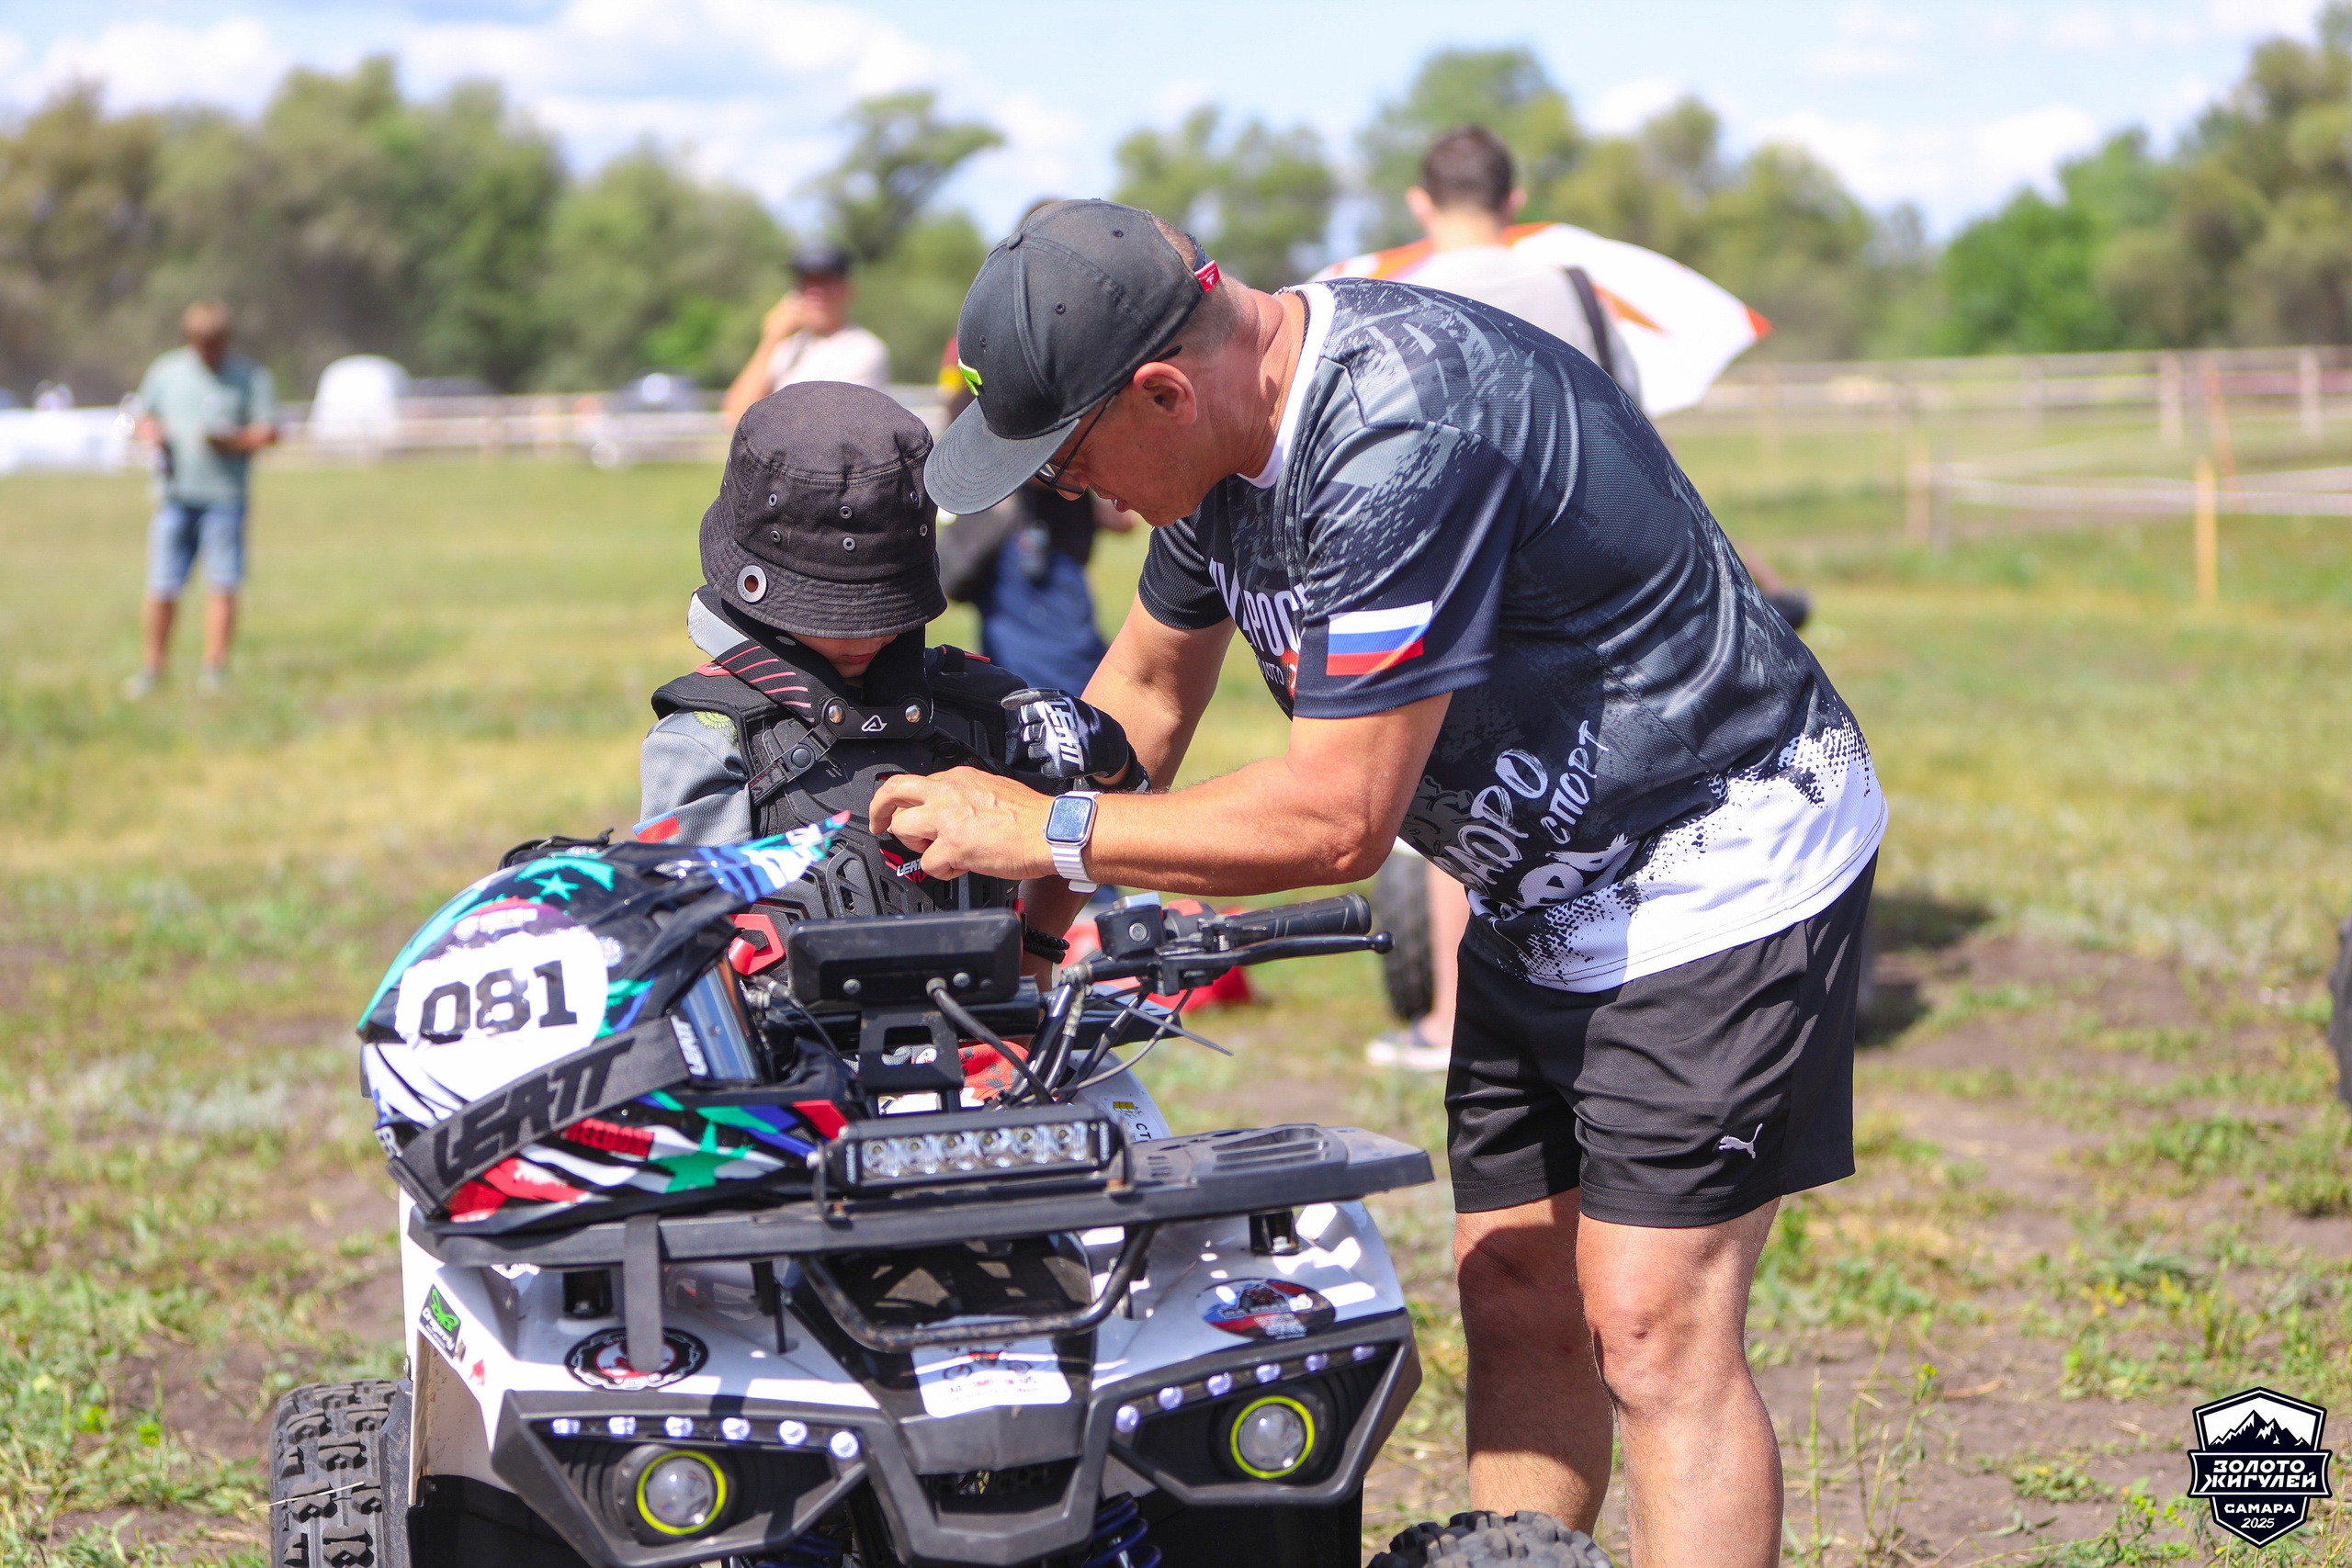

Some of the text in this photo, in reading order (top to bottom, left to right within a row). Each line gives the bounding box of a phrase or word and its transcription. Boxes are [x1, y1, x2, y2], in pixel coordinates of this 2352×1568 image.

[1044, 700, 1085, 773] LEATT
[1540, 719, 1609, 845] СПОРТ
[896, 858, 922, 877] LEAT
[1433, 748, 1549, 897] ВАДРО
[421, 959, 578, 1044] 081
[433, 1036, 636, 1183] LEATT
